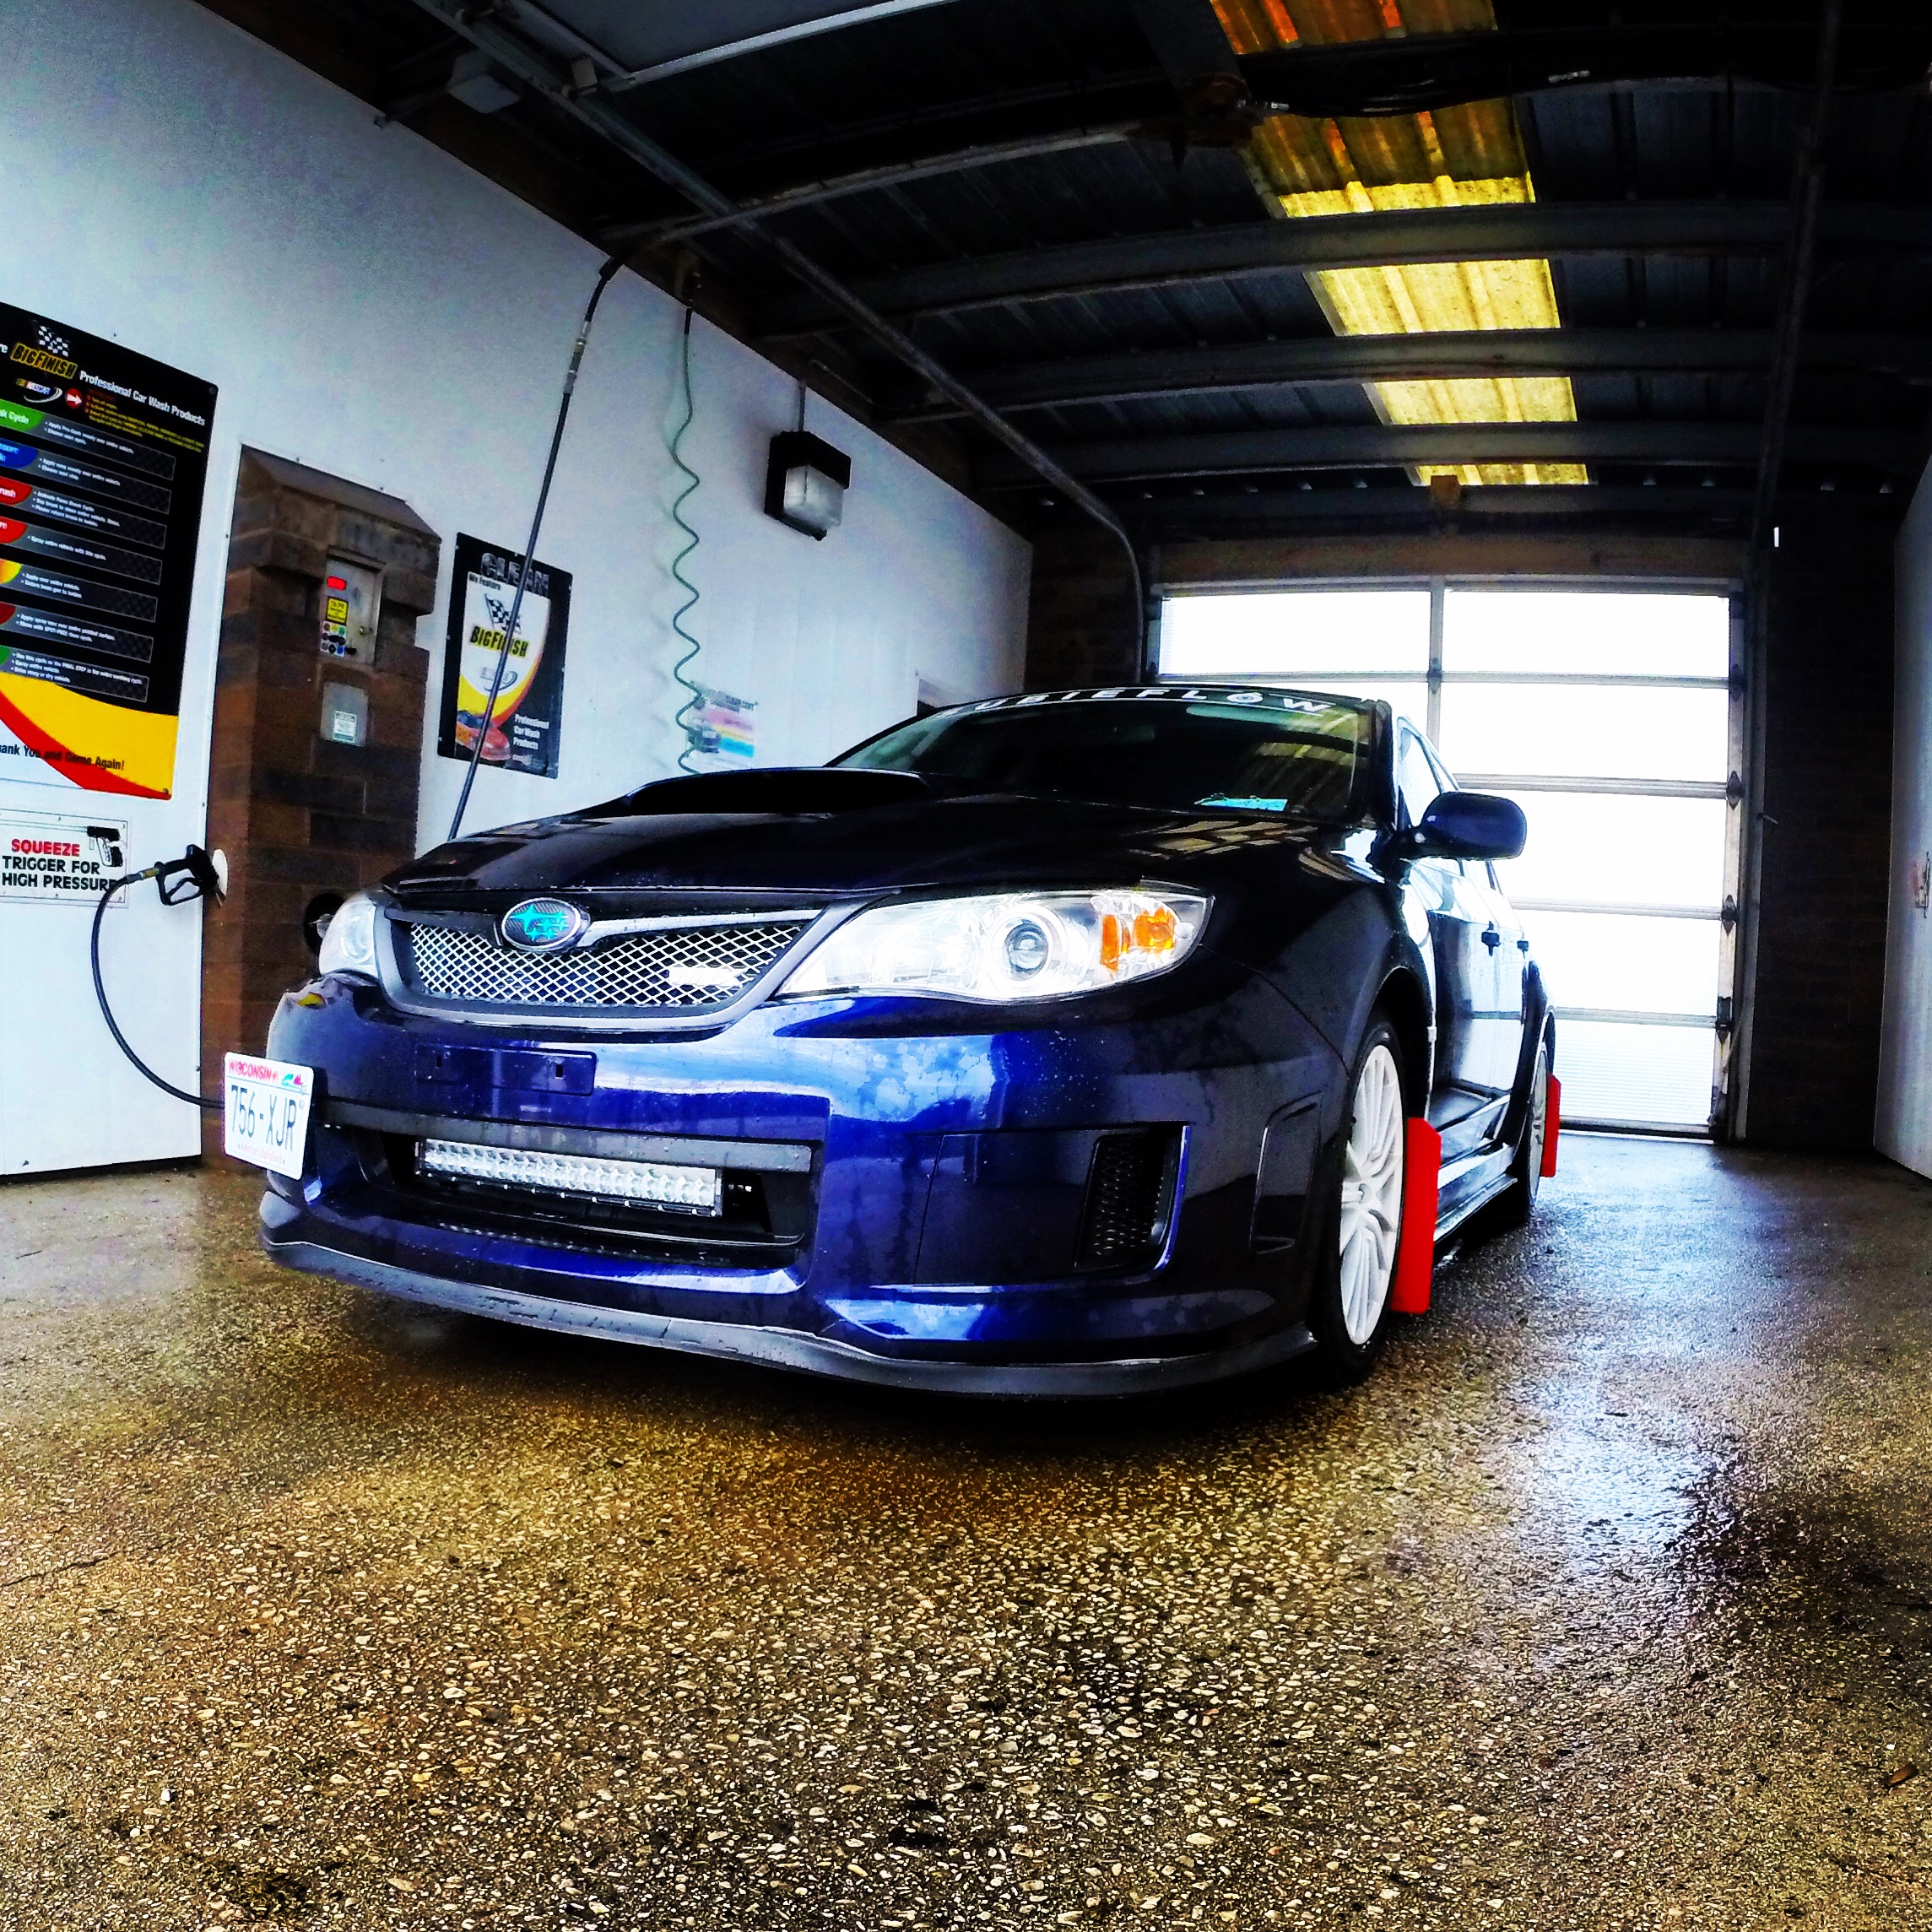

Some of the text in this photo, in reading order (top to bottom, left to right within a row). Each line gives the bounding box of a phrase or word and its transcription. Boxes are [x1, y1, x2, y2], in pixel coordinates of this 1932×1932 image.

[79, 371, 132, 398] Professional
[133, 390, 147, 403] Car
[149, 396, 170, 413] Wash
[171, 405, 205, 426] Products
[469, 625, 528, 658] BIGFIISH
[0, 744, 125, 771] ank You and Come Again!
[11, 838, 80, 858] SQUEEZE
[2, 855, 100, 875] TRIGGER FOR
[2, 872, 38, 888] HIGH
[229, 1059, 273, 1082] WISCONSIN
